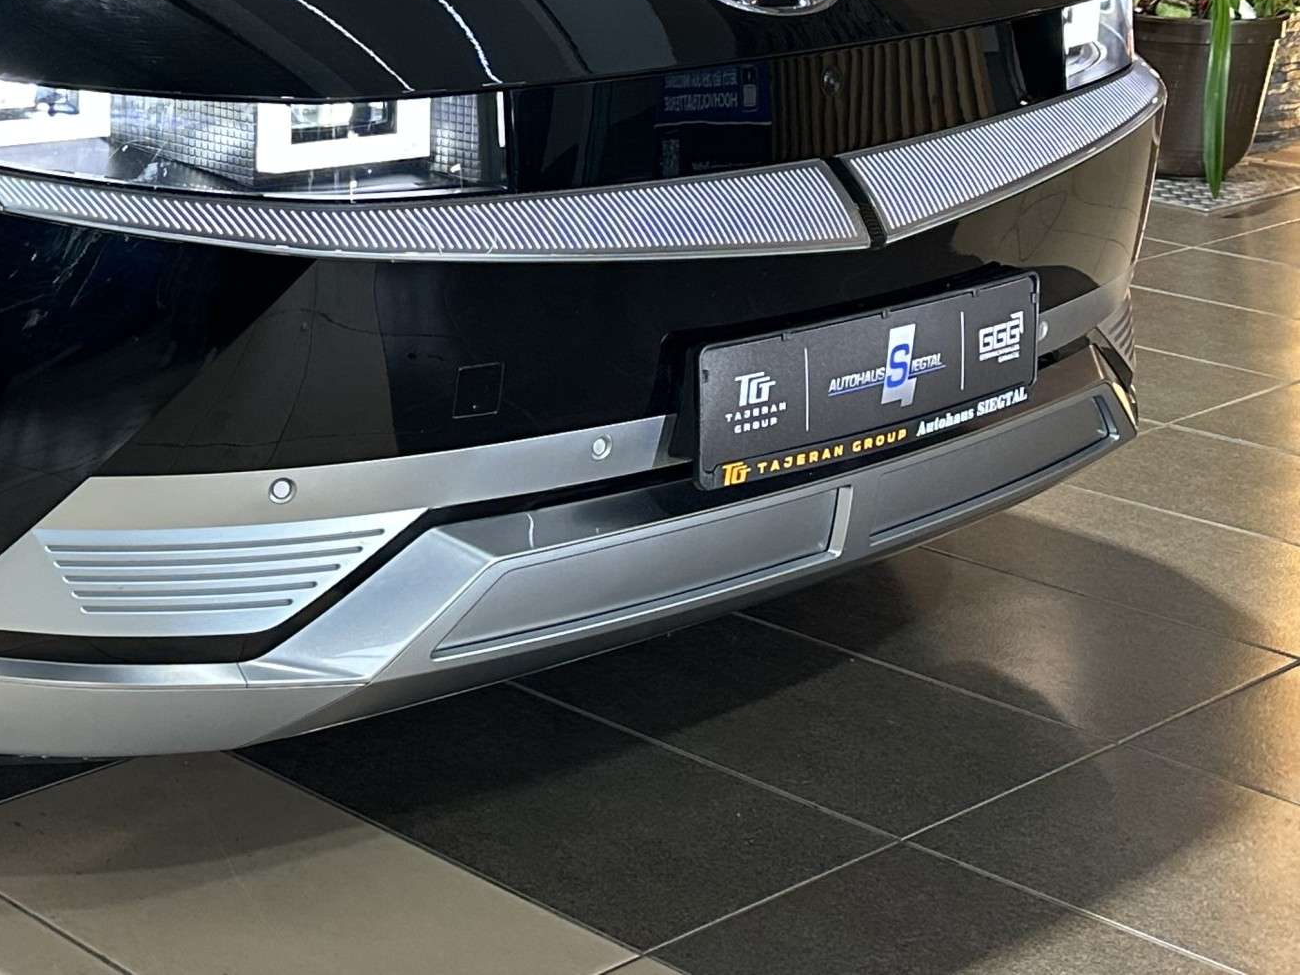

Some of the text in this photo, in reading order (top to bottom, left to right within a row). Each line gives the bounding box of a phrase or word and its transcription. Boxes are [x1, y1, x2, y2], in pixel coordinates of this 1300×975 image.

[828, 366, 886, 393] AUTOHAUS
[724, 401, 787, 423] TAJERAN
[734, 416, 778, 434] GROUP
[756, 444, 844, 474] TAJERAN
[852, 428, 907, 453] GROUP
[916, 407, 975, 437] Autohaus
[976, 386, 1028, 418] SIEGTAL
